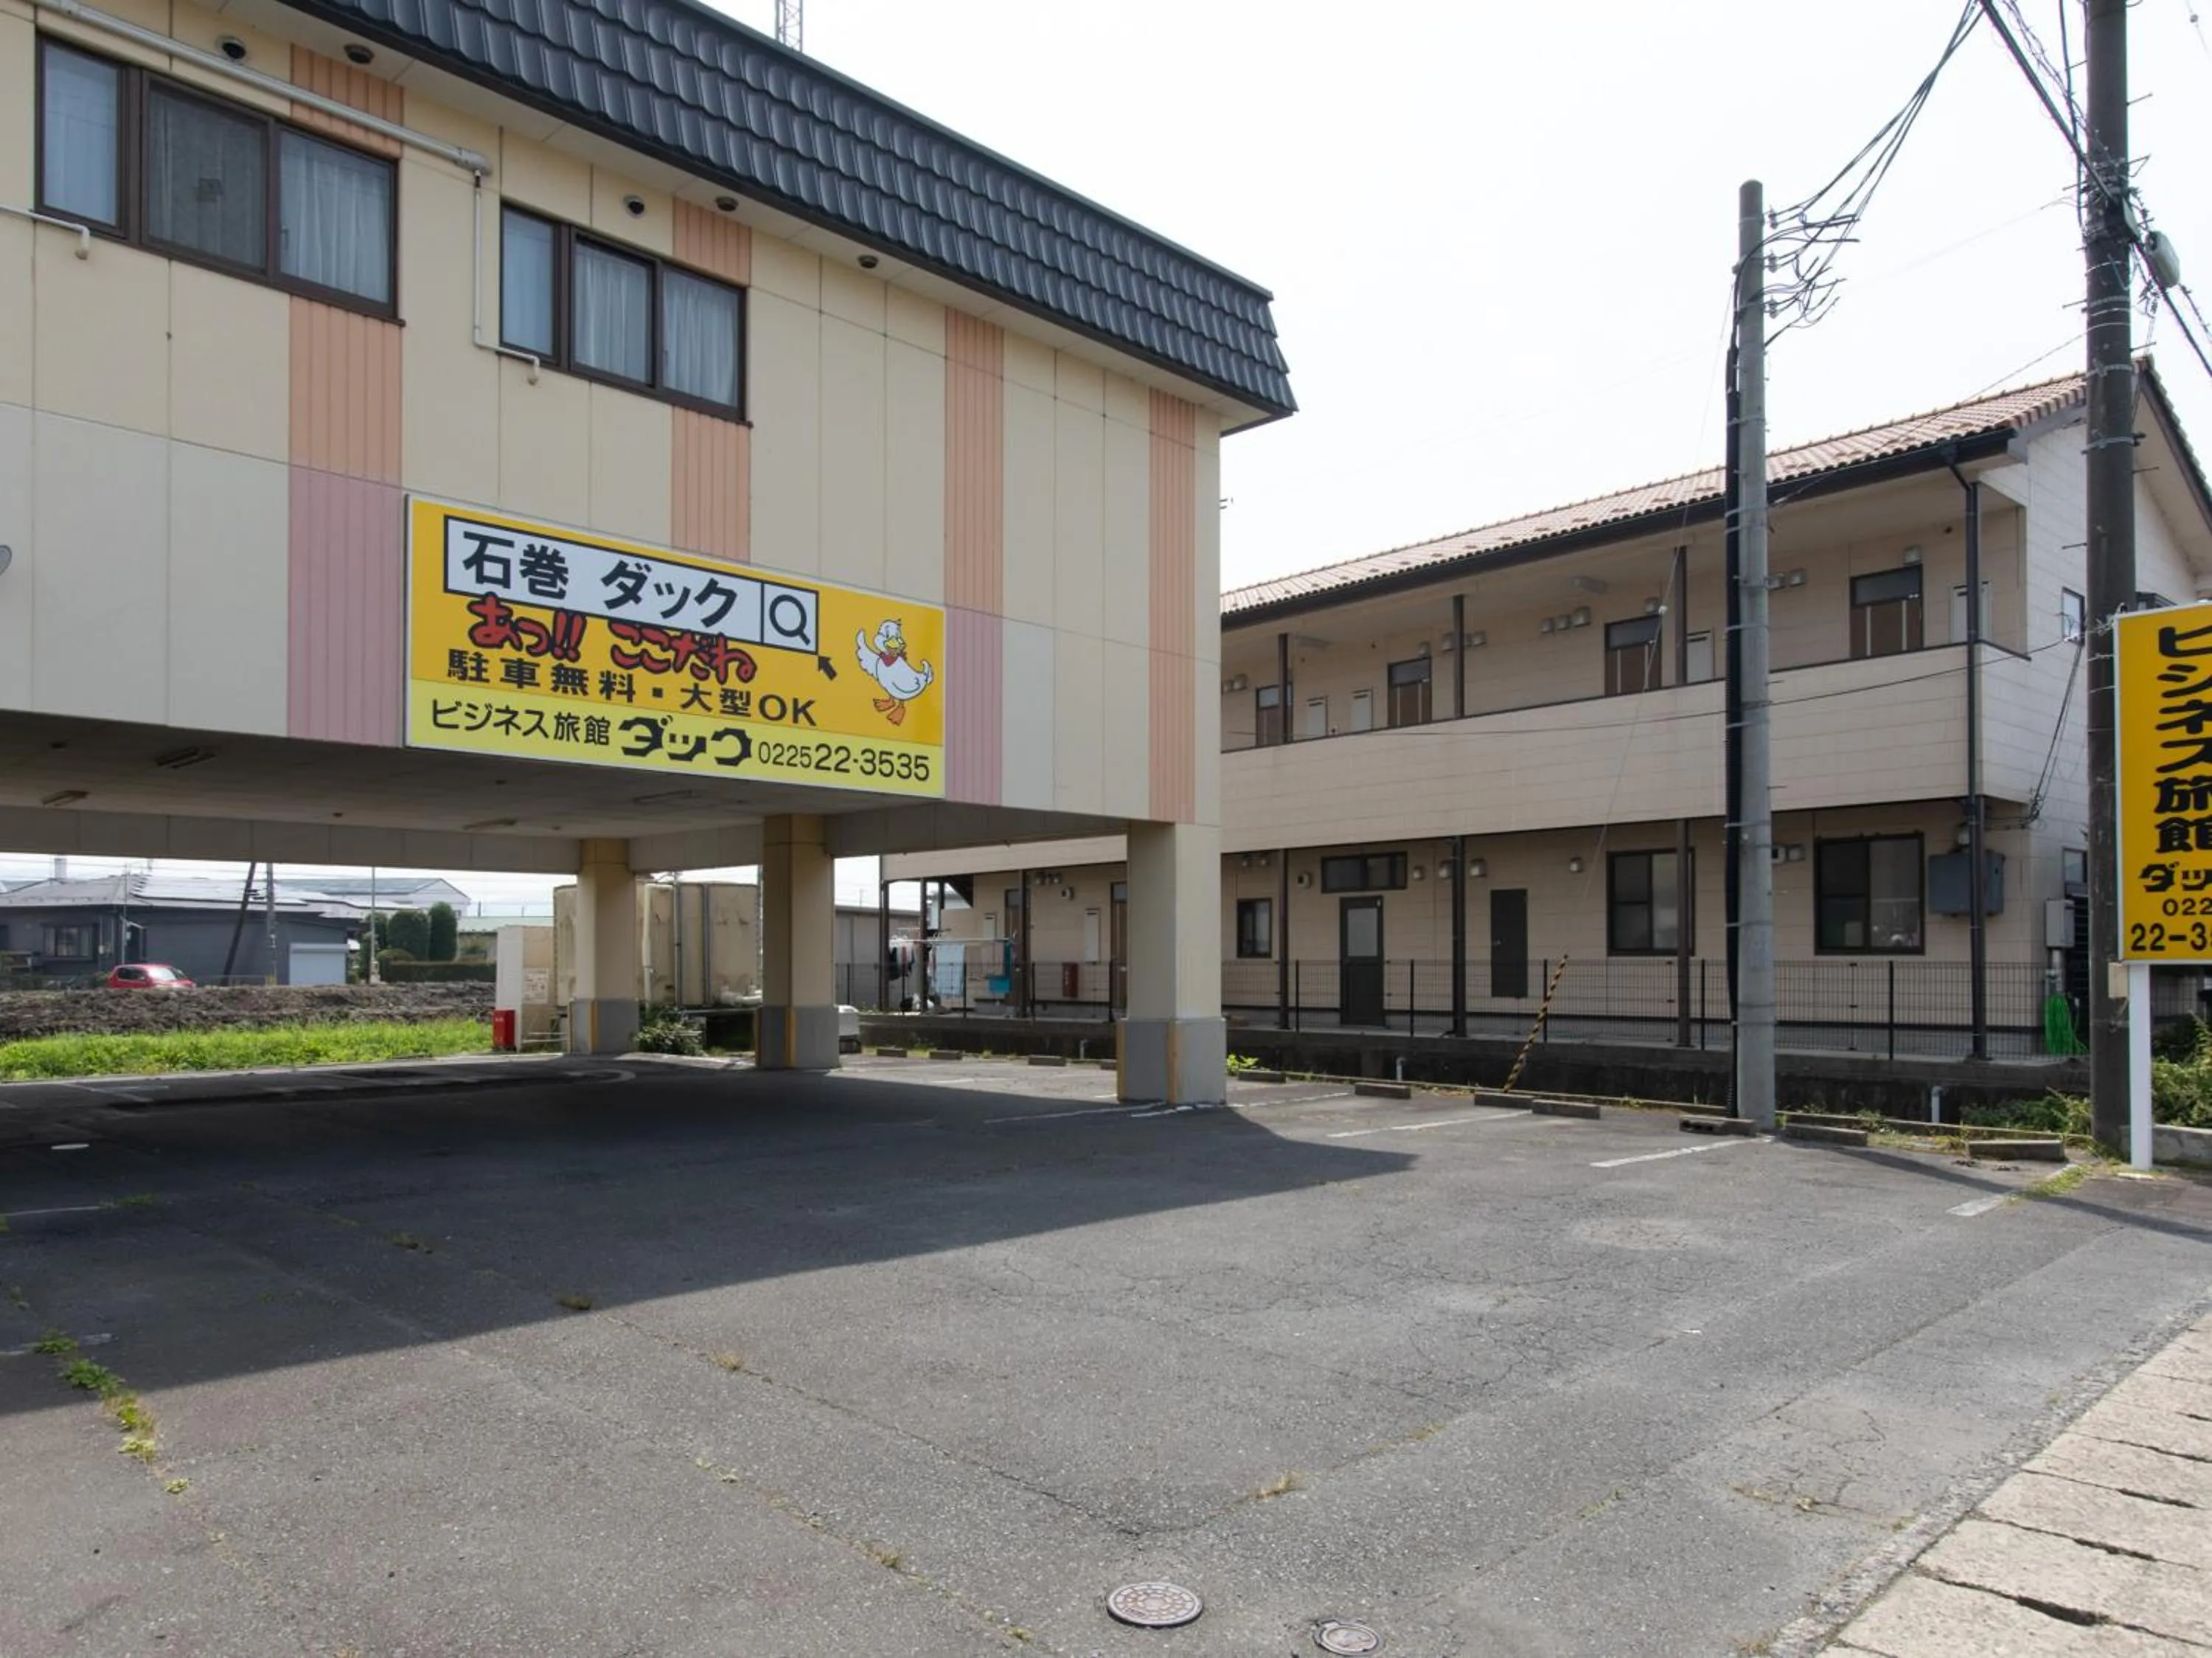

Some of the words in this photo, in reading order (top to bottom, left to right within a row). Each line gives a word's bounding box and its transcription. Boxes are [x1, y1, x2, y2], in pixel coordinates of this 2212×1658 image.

[462, 531, 569, 600] 石巻
[601, 561, 737, 628] ダック
[432, 699, 611, 745] ビジネス旅館
[2131, 922, 2212, 951] 22-3
